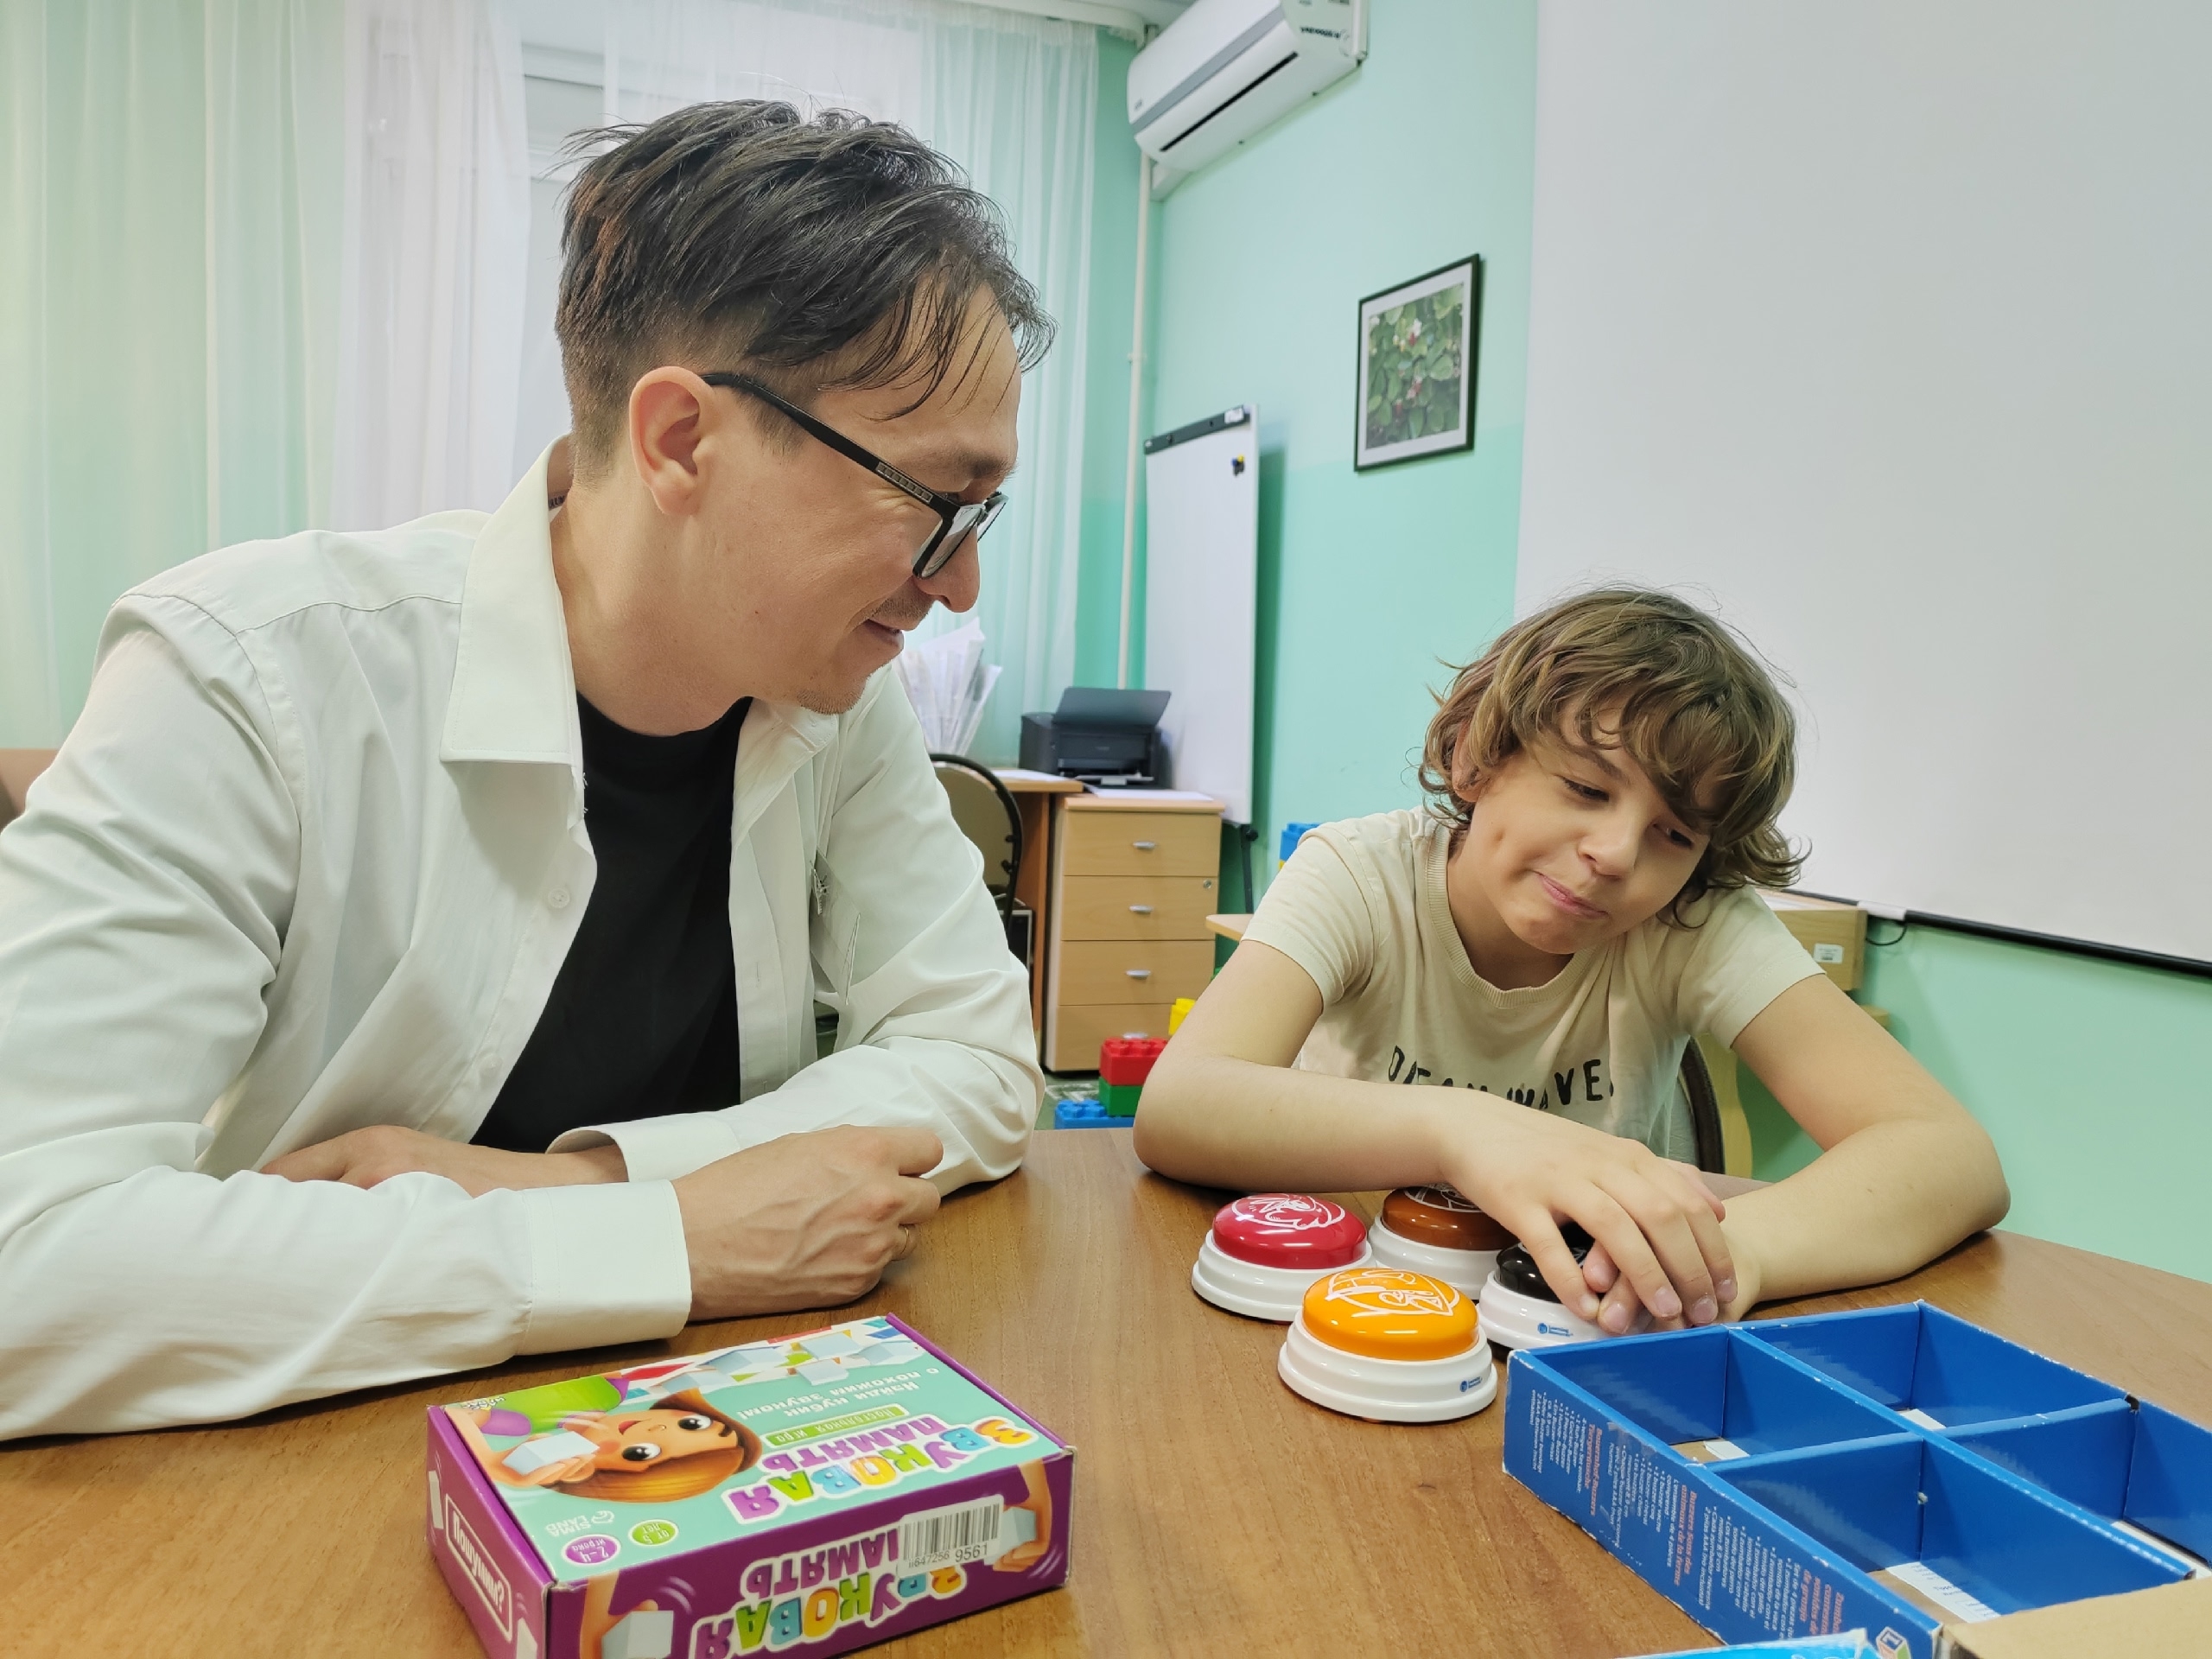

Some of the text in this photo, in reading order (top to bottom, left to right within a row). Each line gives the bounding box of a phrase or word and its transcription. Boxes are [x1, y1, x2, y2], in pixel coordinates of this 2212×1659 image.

[830, 1370, 920, 1395] похожим
[737, 1392, 823, 1420] звуком!
[783, 1382, 920, 1417] Найди кубик
[774, 1408, 893, 1444] Настольная игра
[762, 1417, 946, 1472] ПАМЯТЬ
[727, 1420, 1028, 1521] ЗВУКОВАЯ
[546, 1516, 588, 1531] LAND
[550, 1522, 591, 1536] SIMA
[641, 1522, 660, 1533] лет
[658, 1529, 670, 1539] от
[571, 1539, 606, 1552] игрока
[954, 1544, 988, 1563] 9561
[1799, 1583, 1808, 1622] granja
[1811, 1578, 1821, 1620] sonidos
